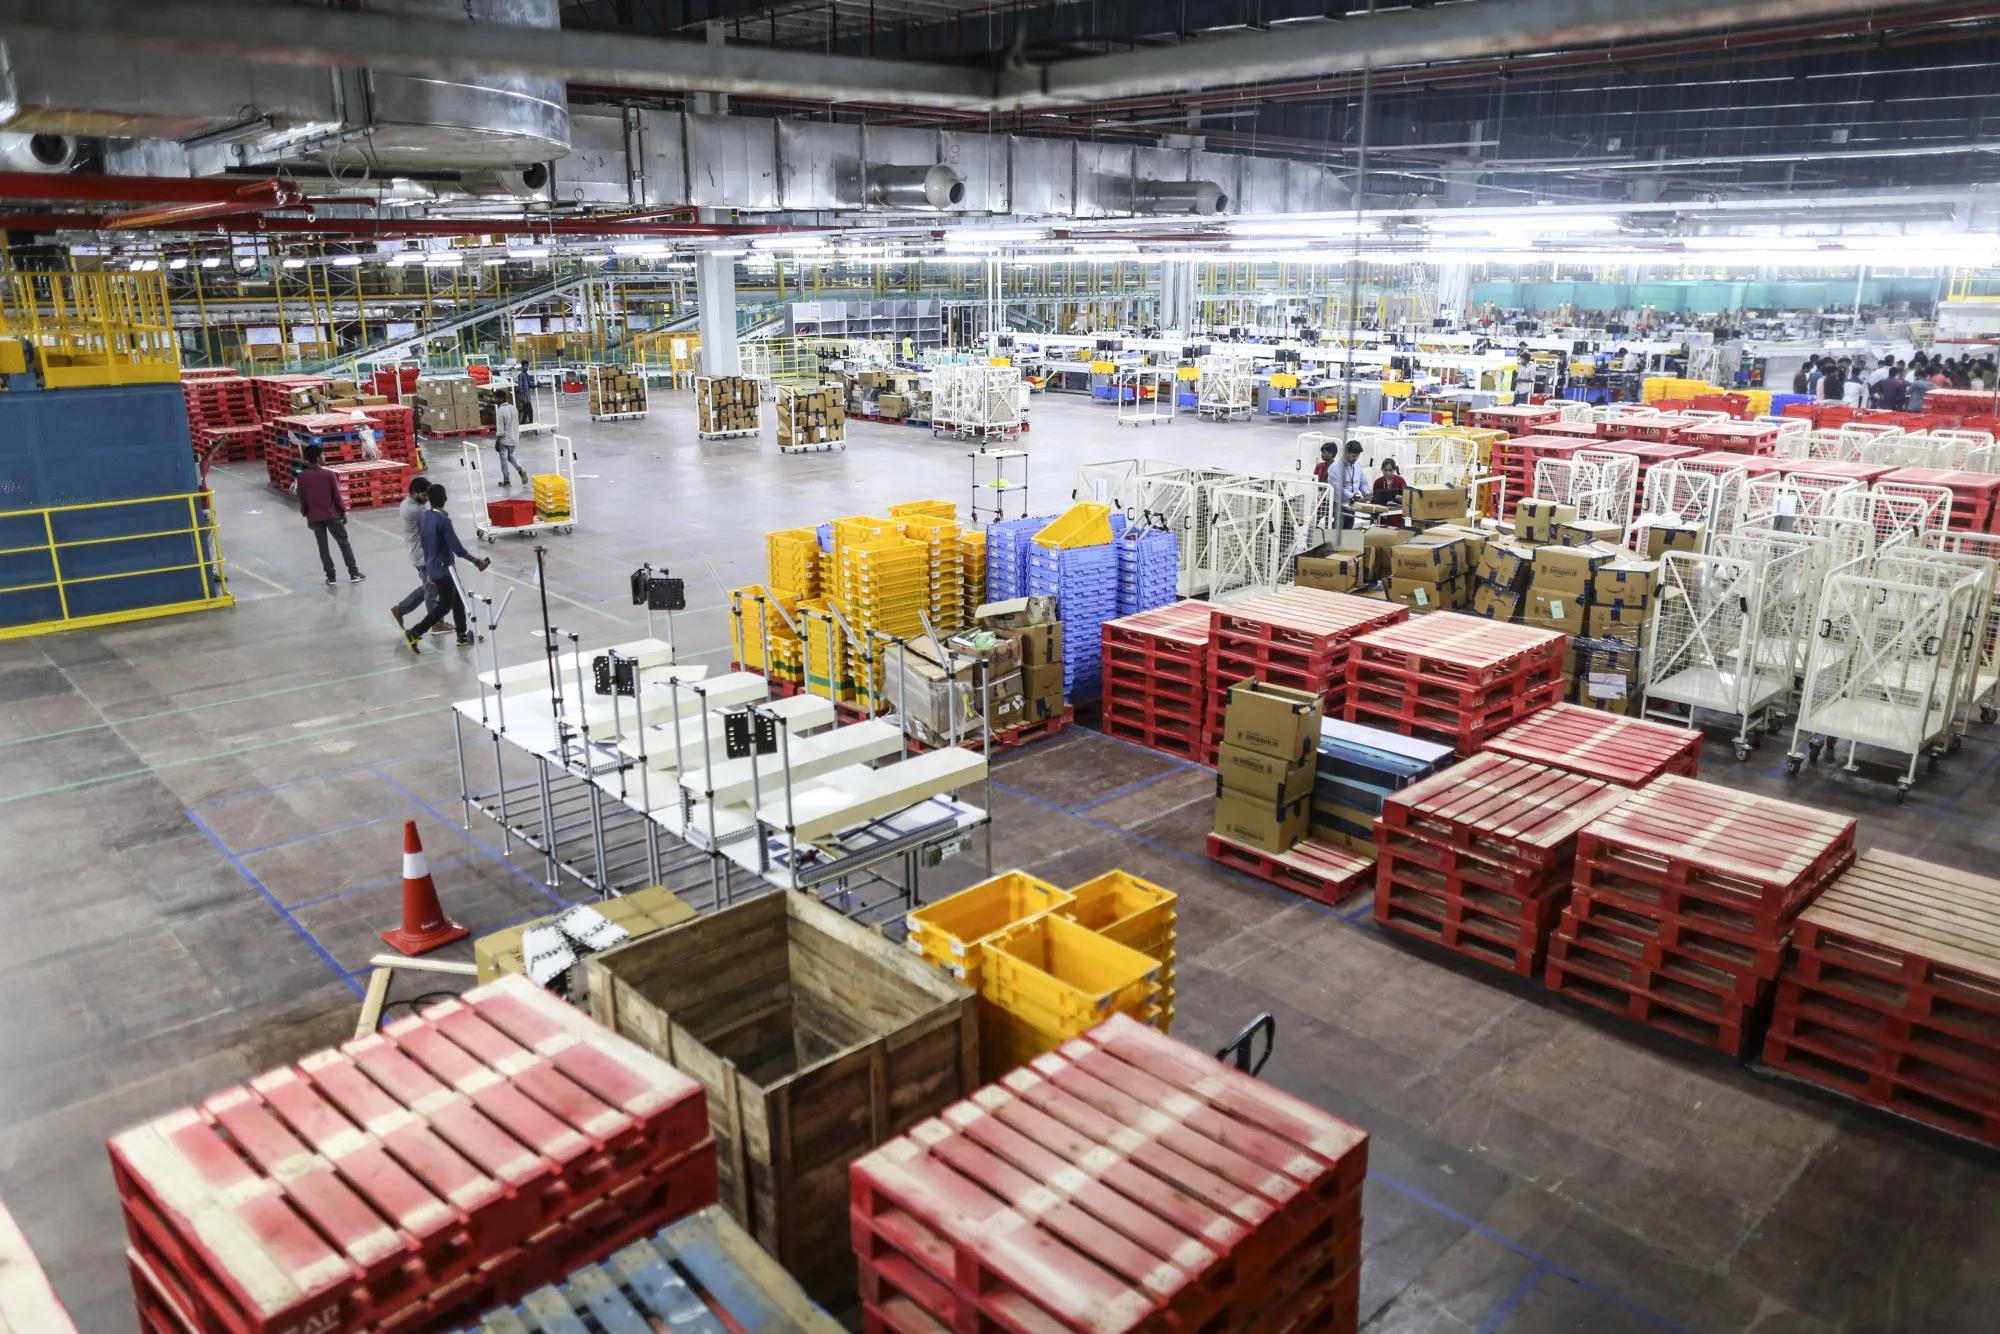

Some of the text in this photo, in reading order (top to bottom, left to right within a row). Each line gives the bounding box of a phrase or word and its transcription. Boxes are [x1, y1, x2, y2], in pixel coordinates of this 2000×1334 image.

[1549, 567, 1577, 577] amazon.in
[1245, 734, 1279, 747] amazon.in
[1233, 827, 1265, 841] amazon.in
